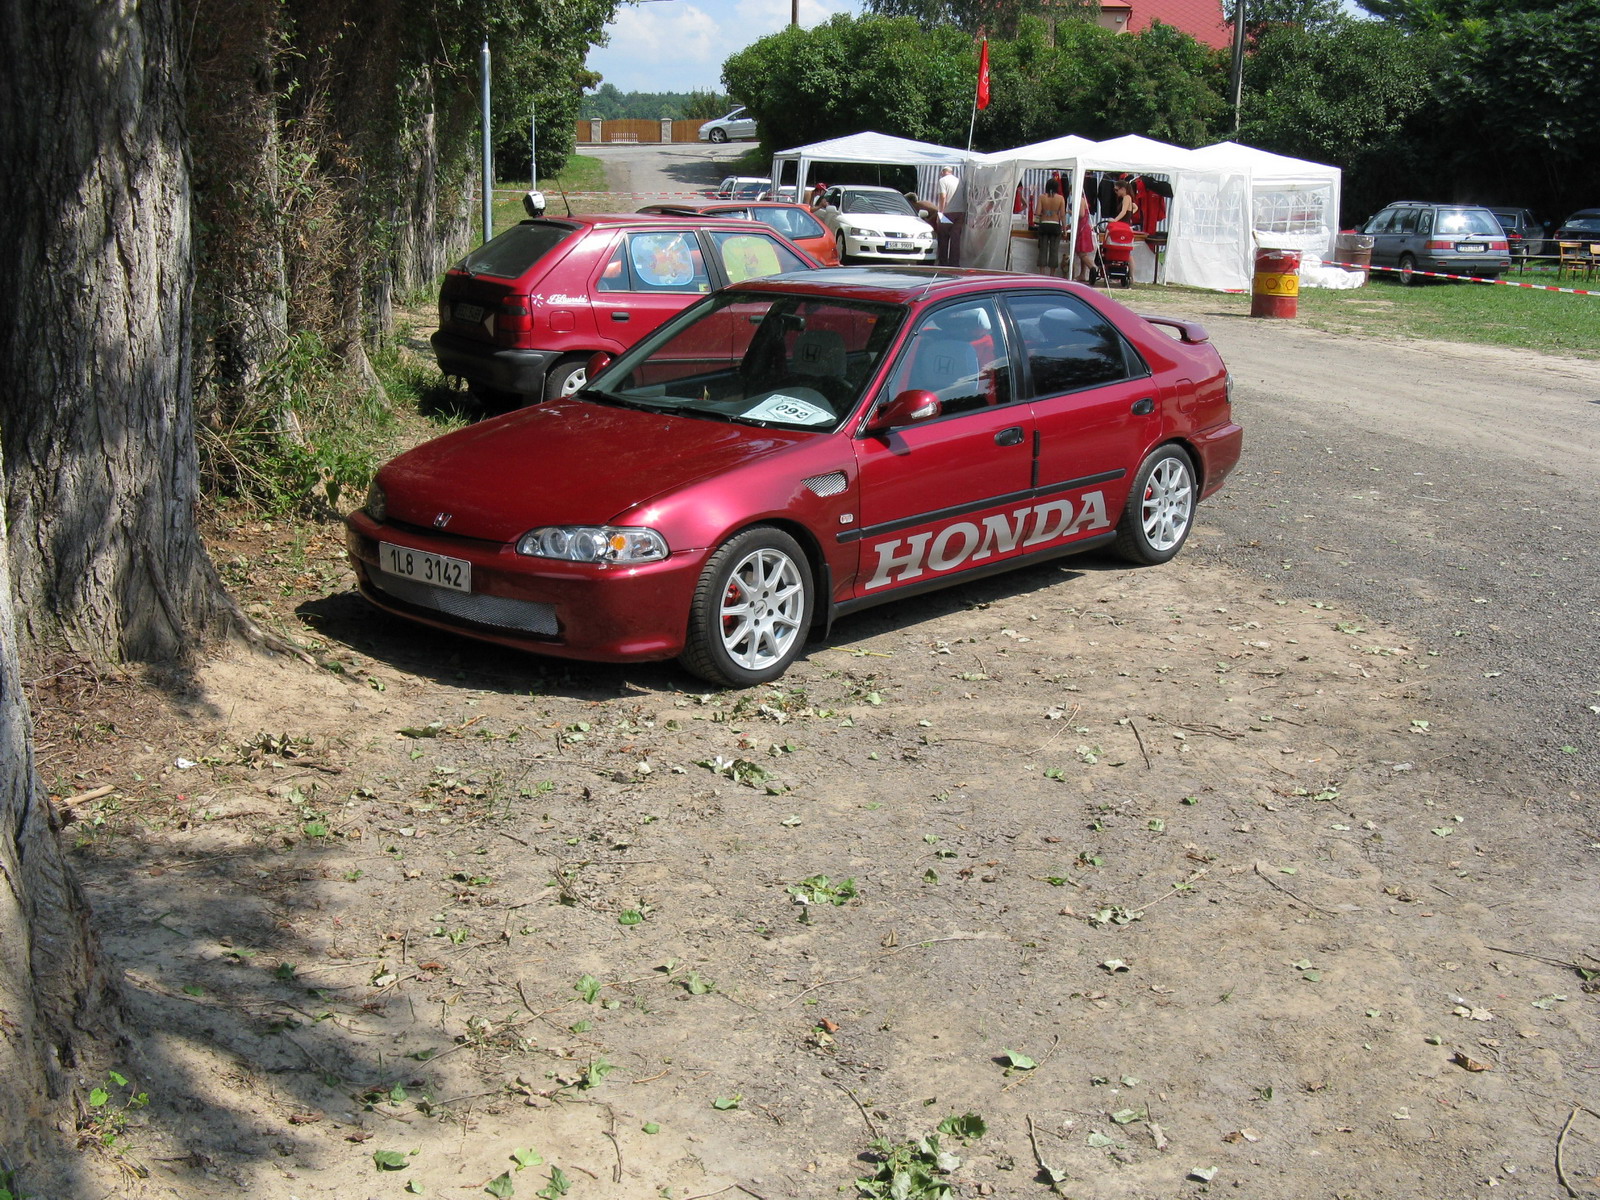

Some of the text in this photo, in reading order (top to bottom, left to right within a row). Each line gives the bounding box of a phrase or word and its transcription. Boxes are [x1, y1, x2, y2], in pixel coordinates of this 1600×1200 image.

[391, 549, 462, 587] 1L8 3142
[865, 491, 1110, 590] HONDA
